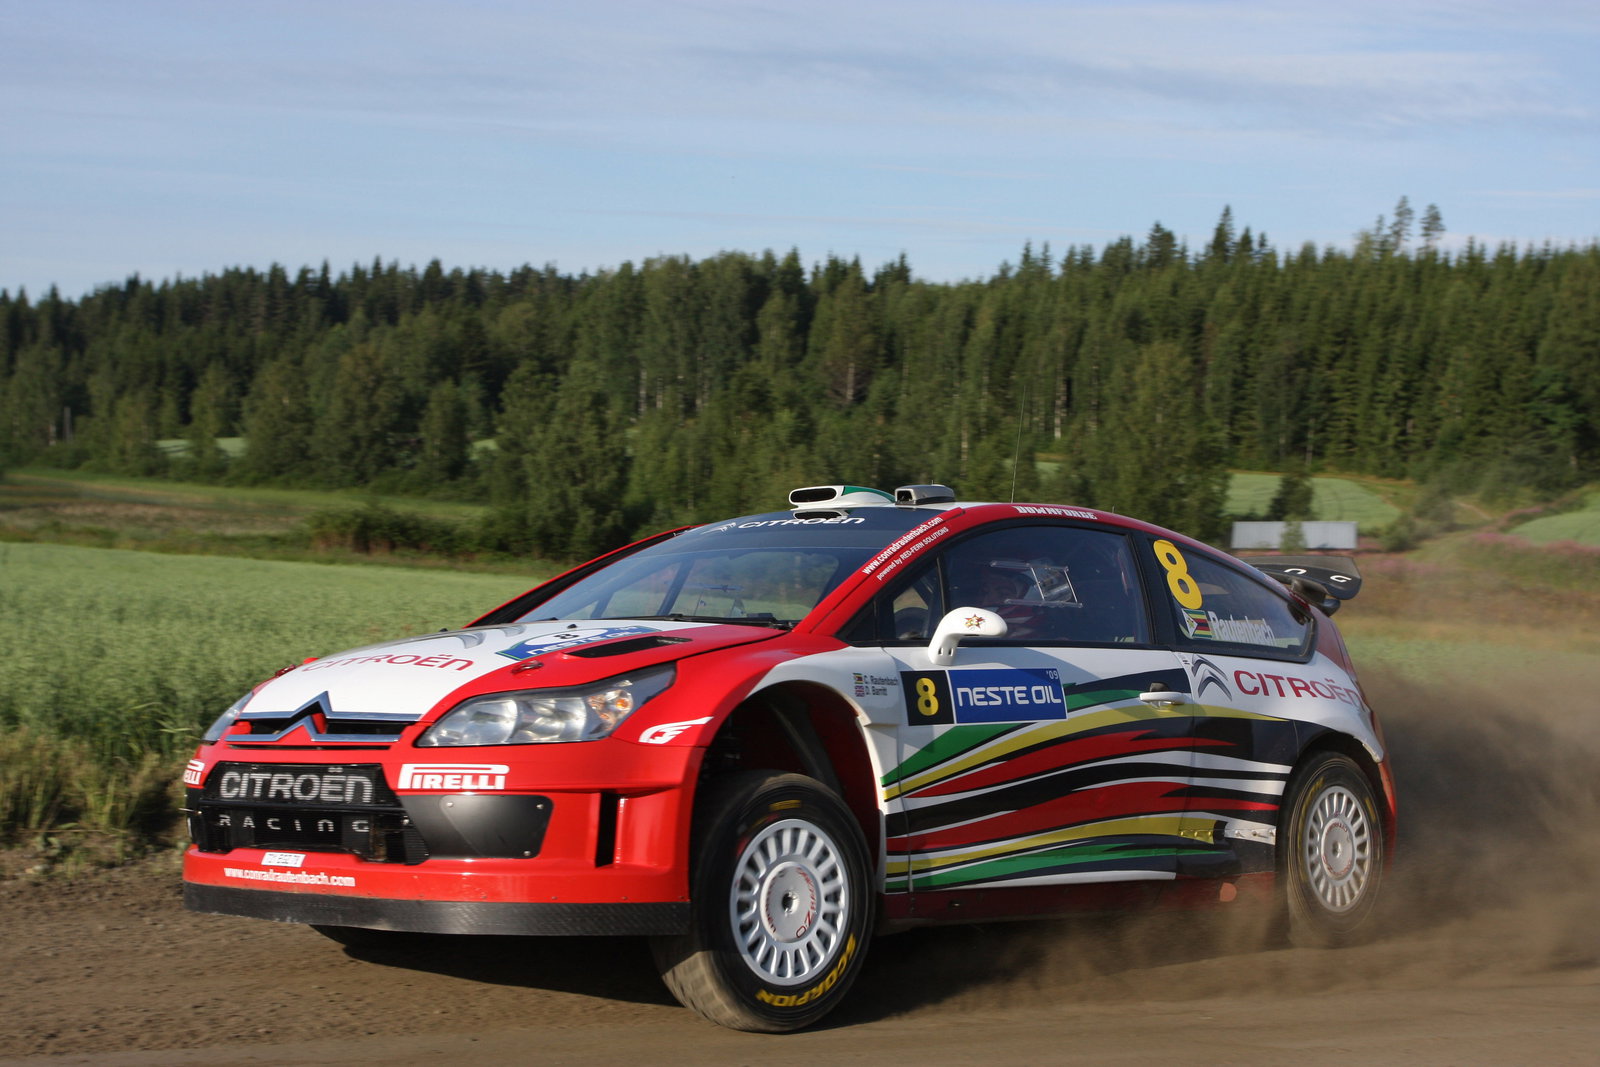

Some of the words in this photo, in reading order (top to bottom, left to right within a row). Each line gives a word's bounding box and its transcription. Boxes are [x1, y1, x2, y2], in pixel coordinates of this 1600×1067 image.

[1012, 505, 1098, 520] DOWNFORCE
[862, 517, 944, 575] www.conradrautenbach.com
[876, 561, 897, 581] powered
[894, 557, 903, 566] by
[899, 541, 925, 561] RED-FERN
[922, 526, 949, 545] SOLUTIONS
[1153, 539, 1203, 610] 8
[1207, 611, 1276, 646] Rautenbach
[915, 677, 939, 716] 8
[957, 686, 1029, 706] NESTE
[1031, 685, 1062, 704] OIL
[220, 766, 372, 803] CITROËN
[397, 763, 510, 790] PIRELLI
